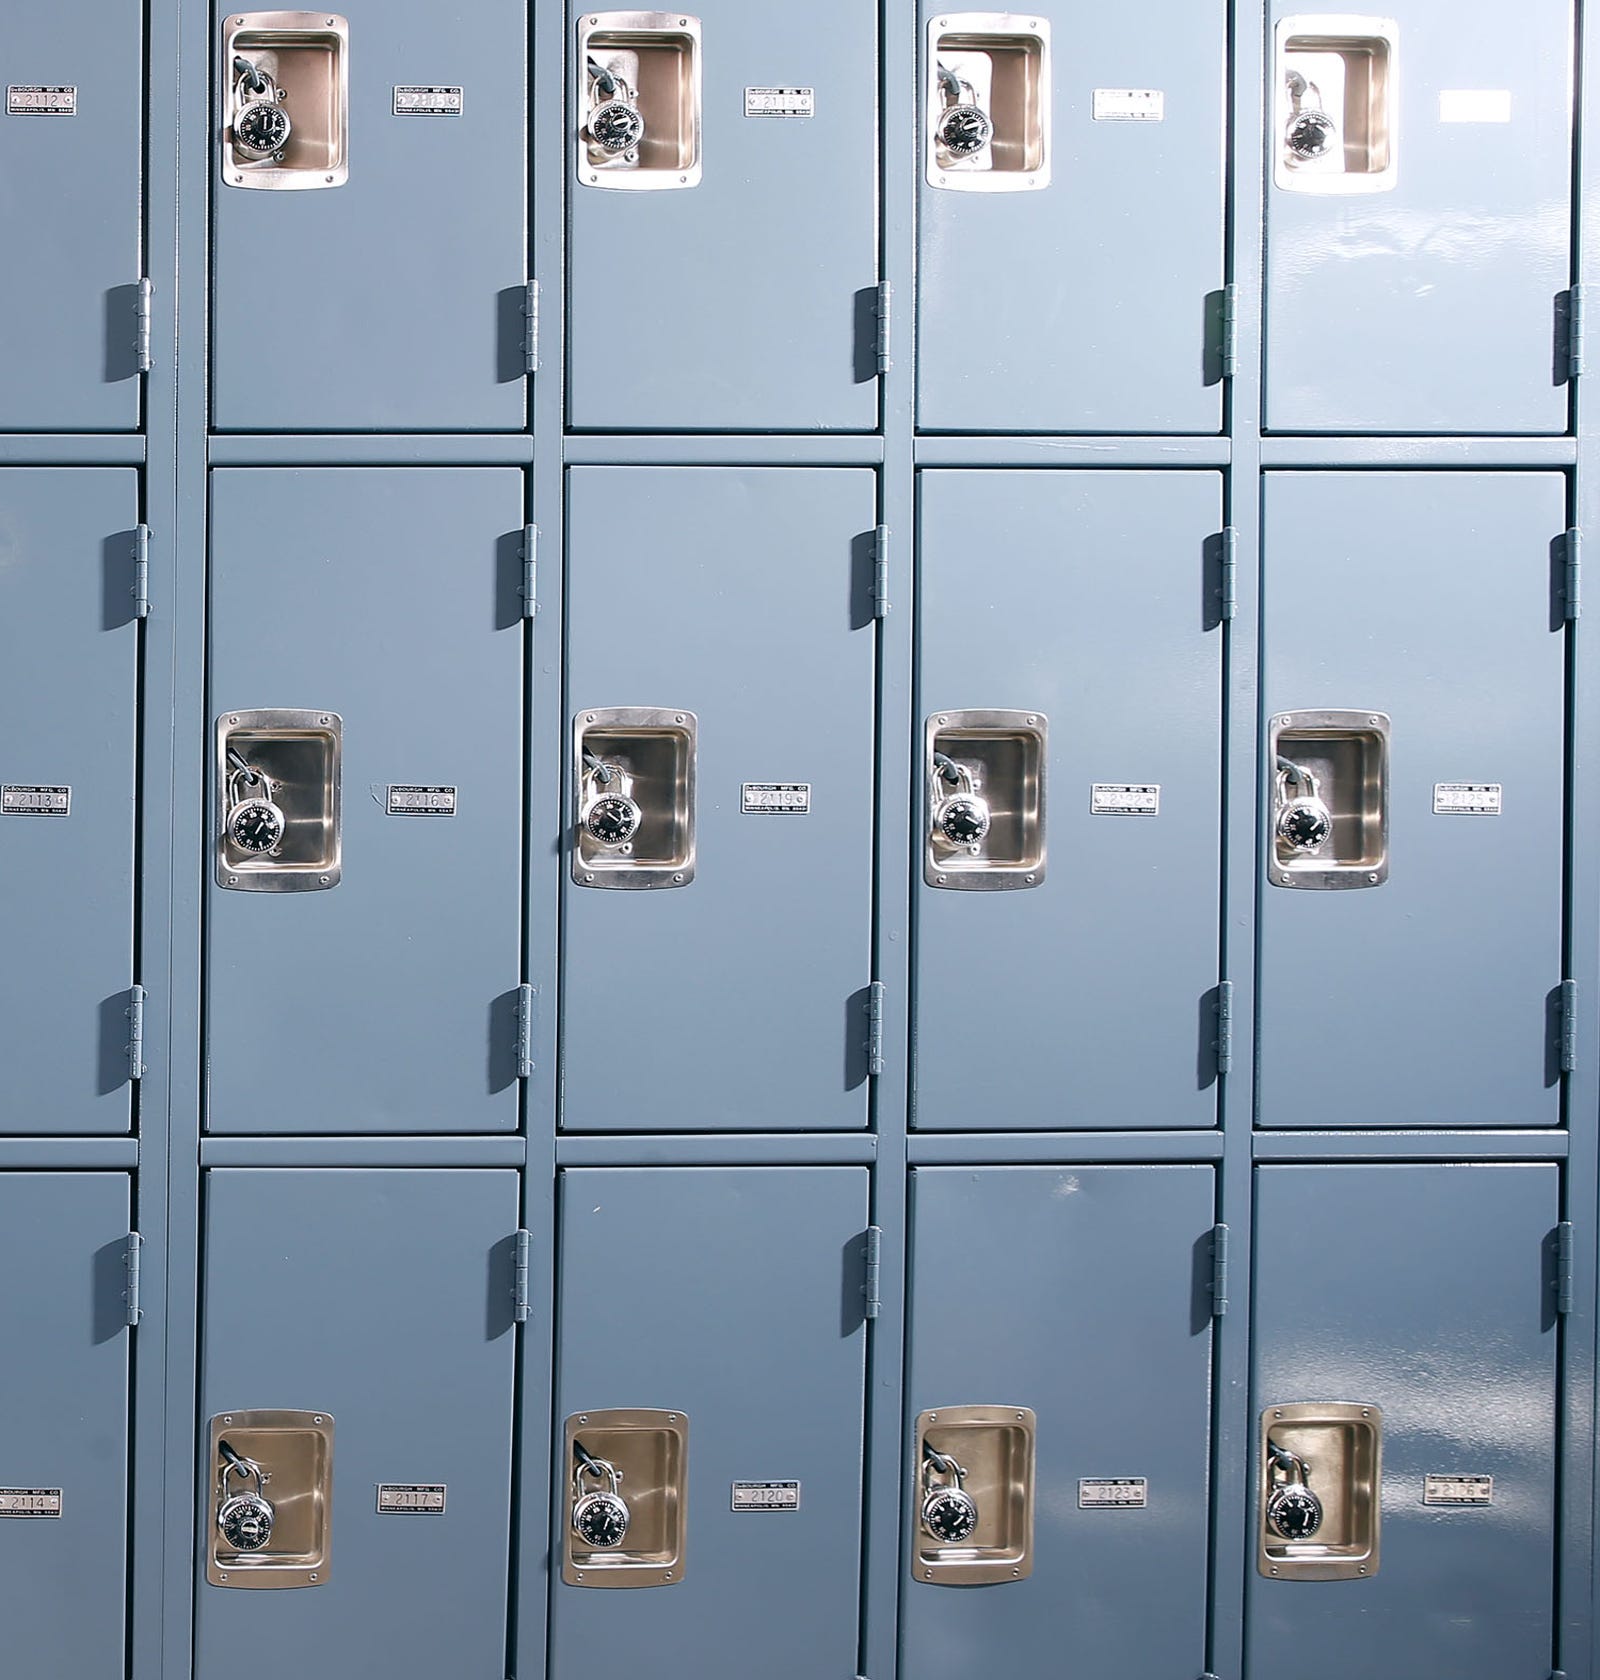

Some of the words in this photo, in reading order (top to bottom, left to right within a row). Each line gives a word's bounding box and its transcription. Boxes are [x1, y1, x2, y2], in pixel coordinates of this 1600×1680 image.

[26, 94, 57, 106] 2112
[19, 794, 51, 807] 2113
[406, 794, 438, 806] 2116
[761, 793, 792, 805] 2119
[396, 1493, 428, 1505] 2117
[752, 1490, 783, 1502] 2120
[1099, 1487, 1130, 1499] 2123
[12, 1497, 44, 1508] 2114
